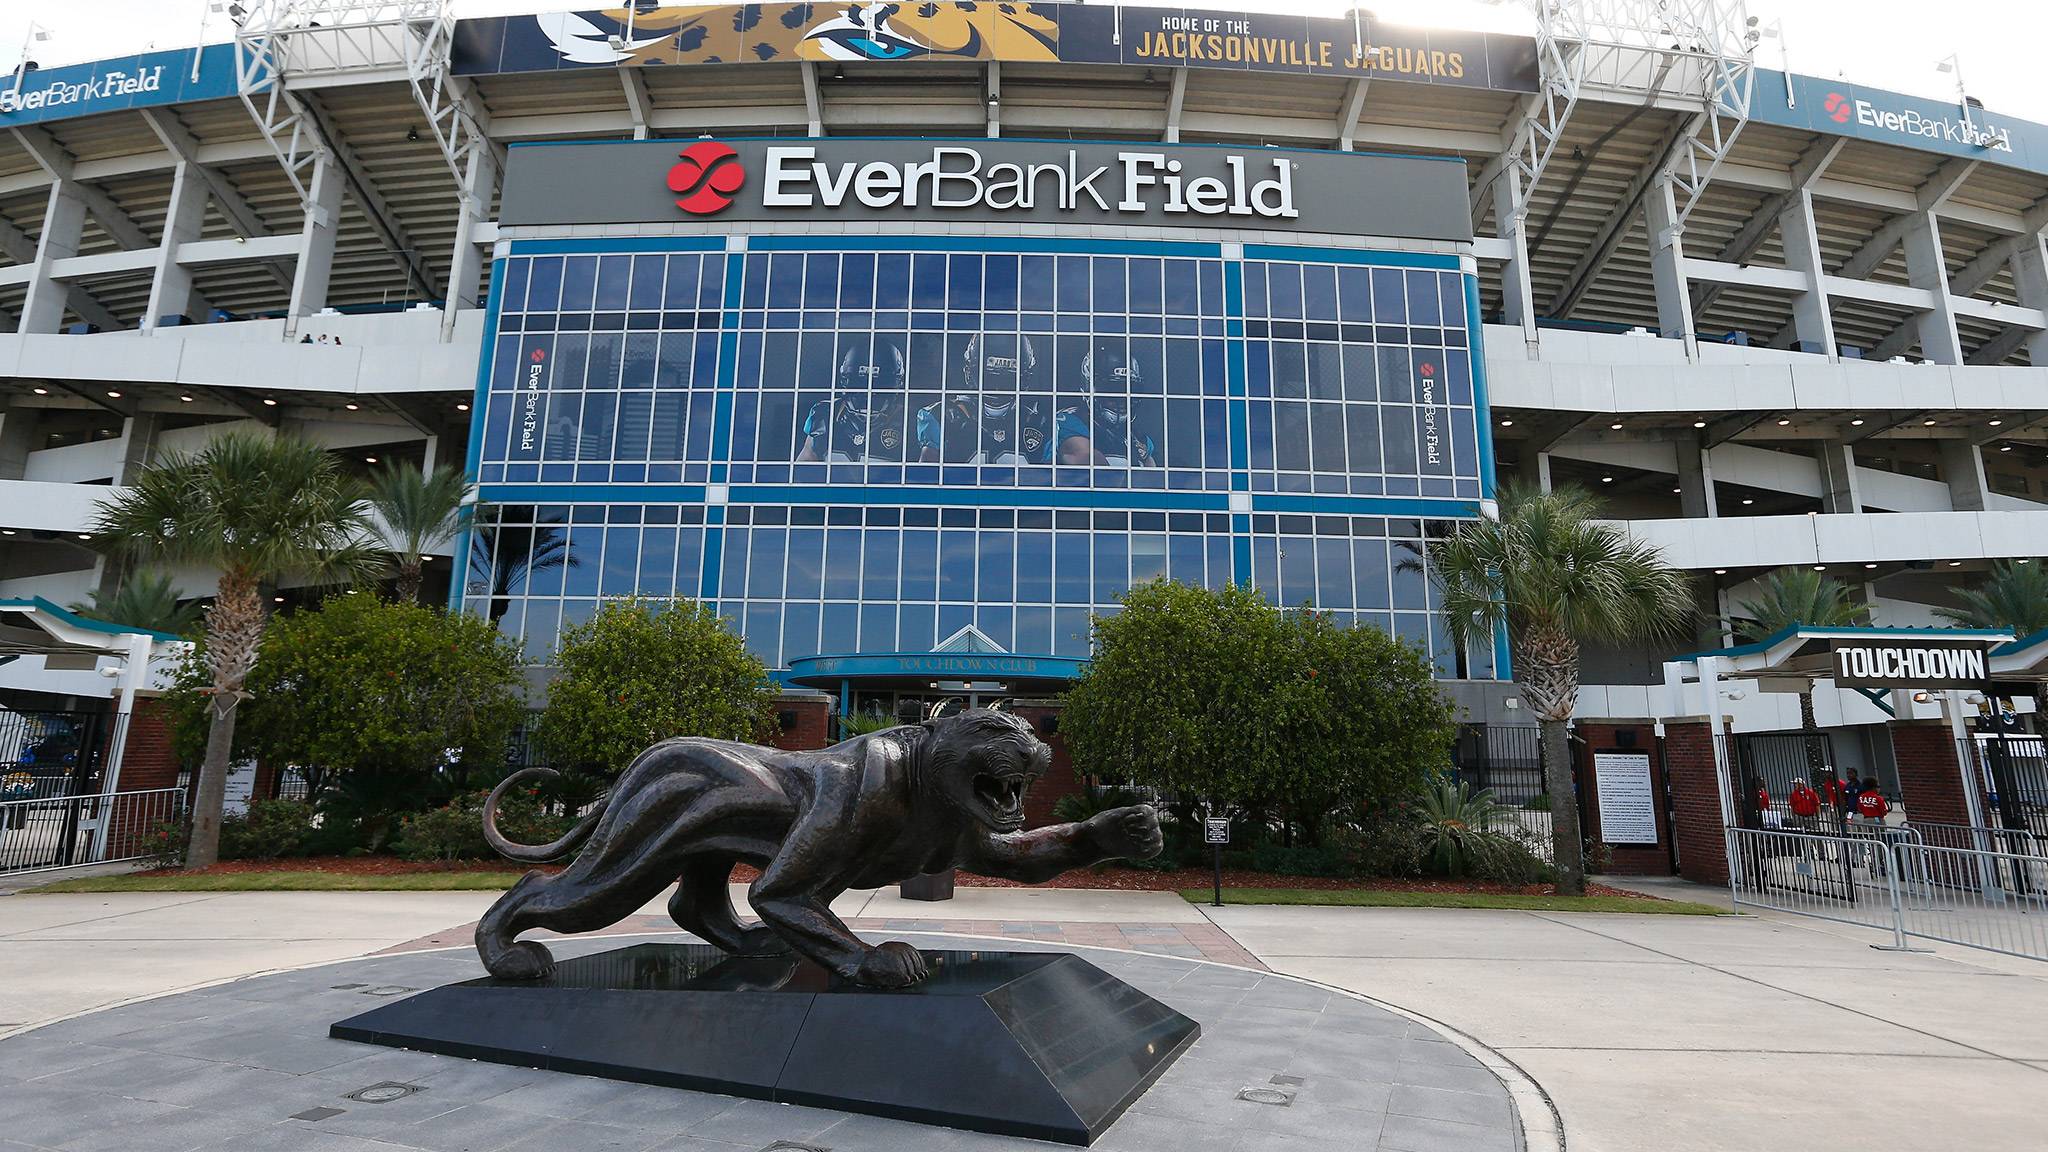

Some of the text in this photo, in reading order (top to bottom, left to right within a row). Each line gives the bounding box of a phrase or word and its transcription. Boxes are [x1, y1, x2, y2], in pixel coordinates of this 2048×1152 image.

[1162, 17, 1250, 34] HOME OF THE
[1136, 31, 1464, 78] JACKSONVILLE JAGUARS
[0, 66, 161, 112] EverBank Field
[1855, 99, 1961, 143] EverBank
[762, 146, 1299, 219] EverBank Field
[521, 364, 542, 450] EverBank Field
[1422, 379, 1440, 464] EverBank Field
[1001, 658, 1037, 672] CLUB
[1835, 647, 1986, 680] TOUCHDOWN
